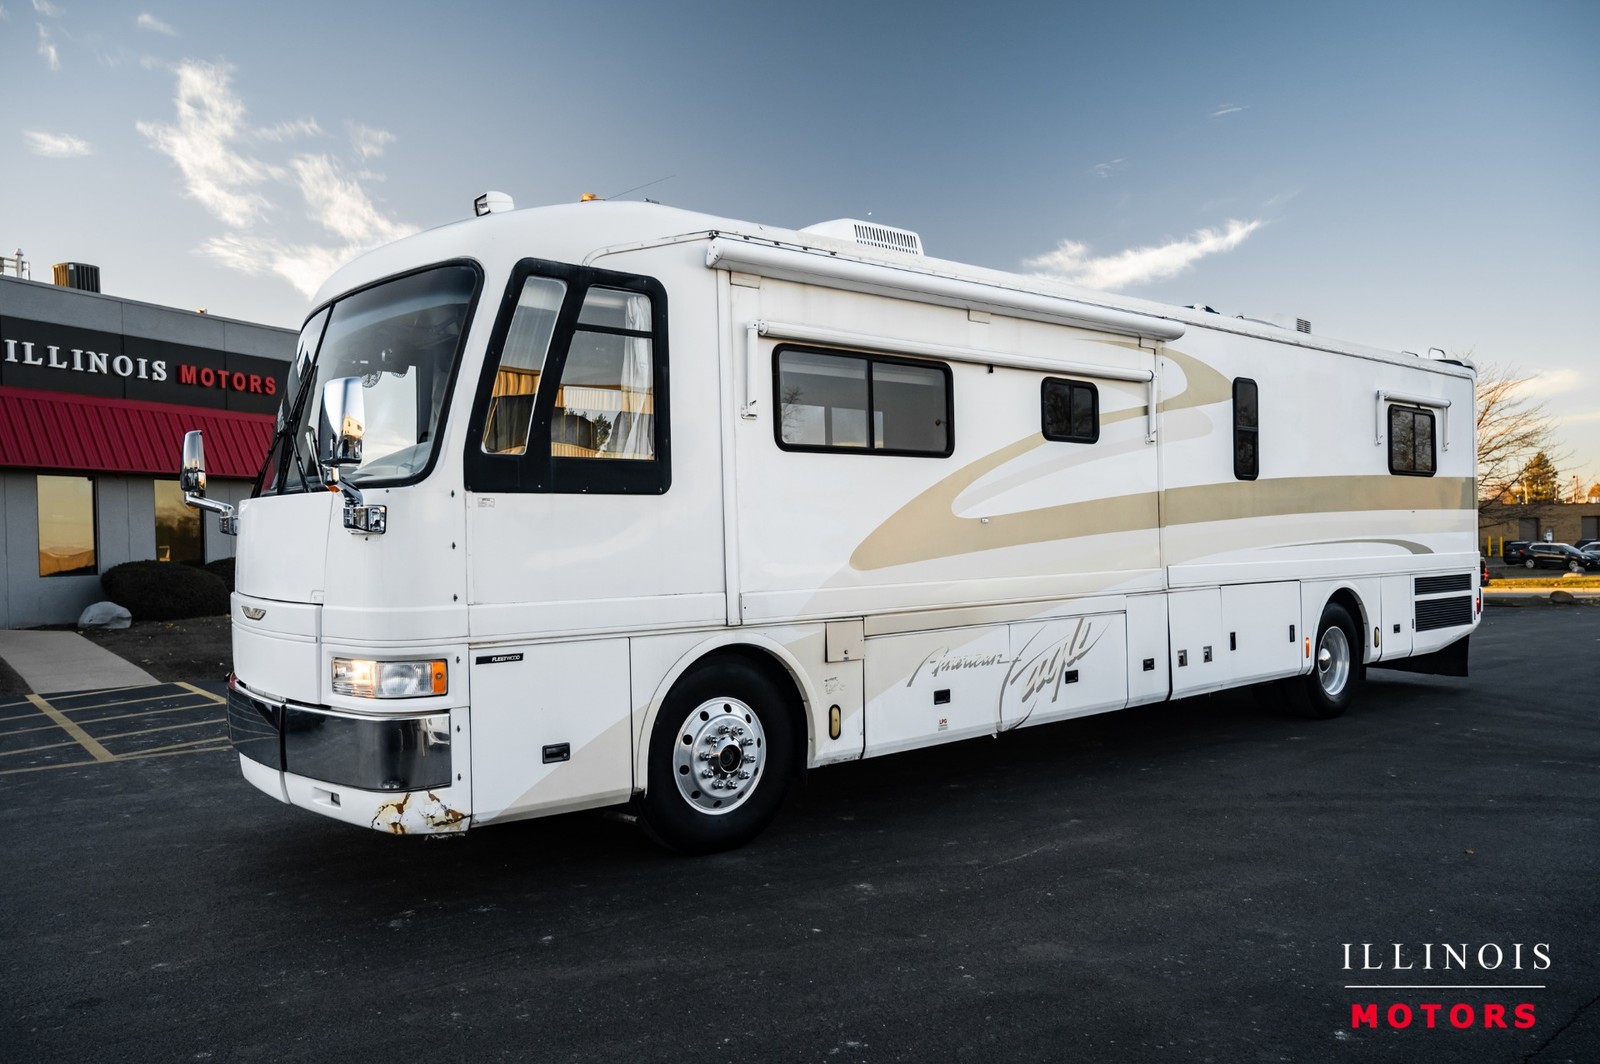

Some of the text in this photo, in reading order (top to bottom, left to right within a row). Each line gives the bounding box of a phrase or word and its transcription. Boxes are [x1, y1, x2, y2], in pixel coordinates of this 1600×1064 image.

[4, 339, 277, 396] ILLINOIS MOTORS
[491, 654, 521, 662] FLEETWOOD
